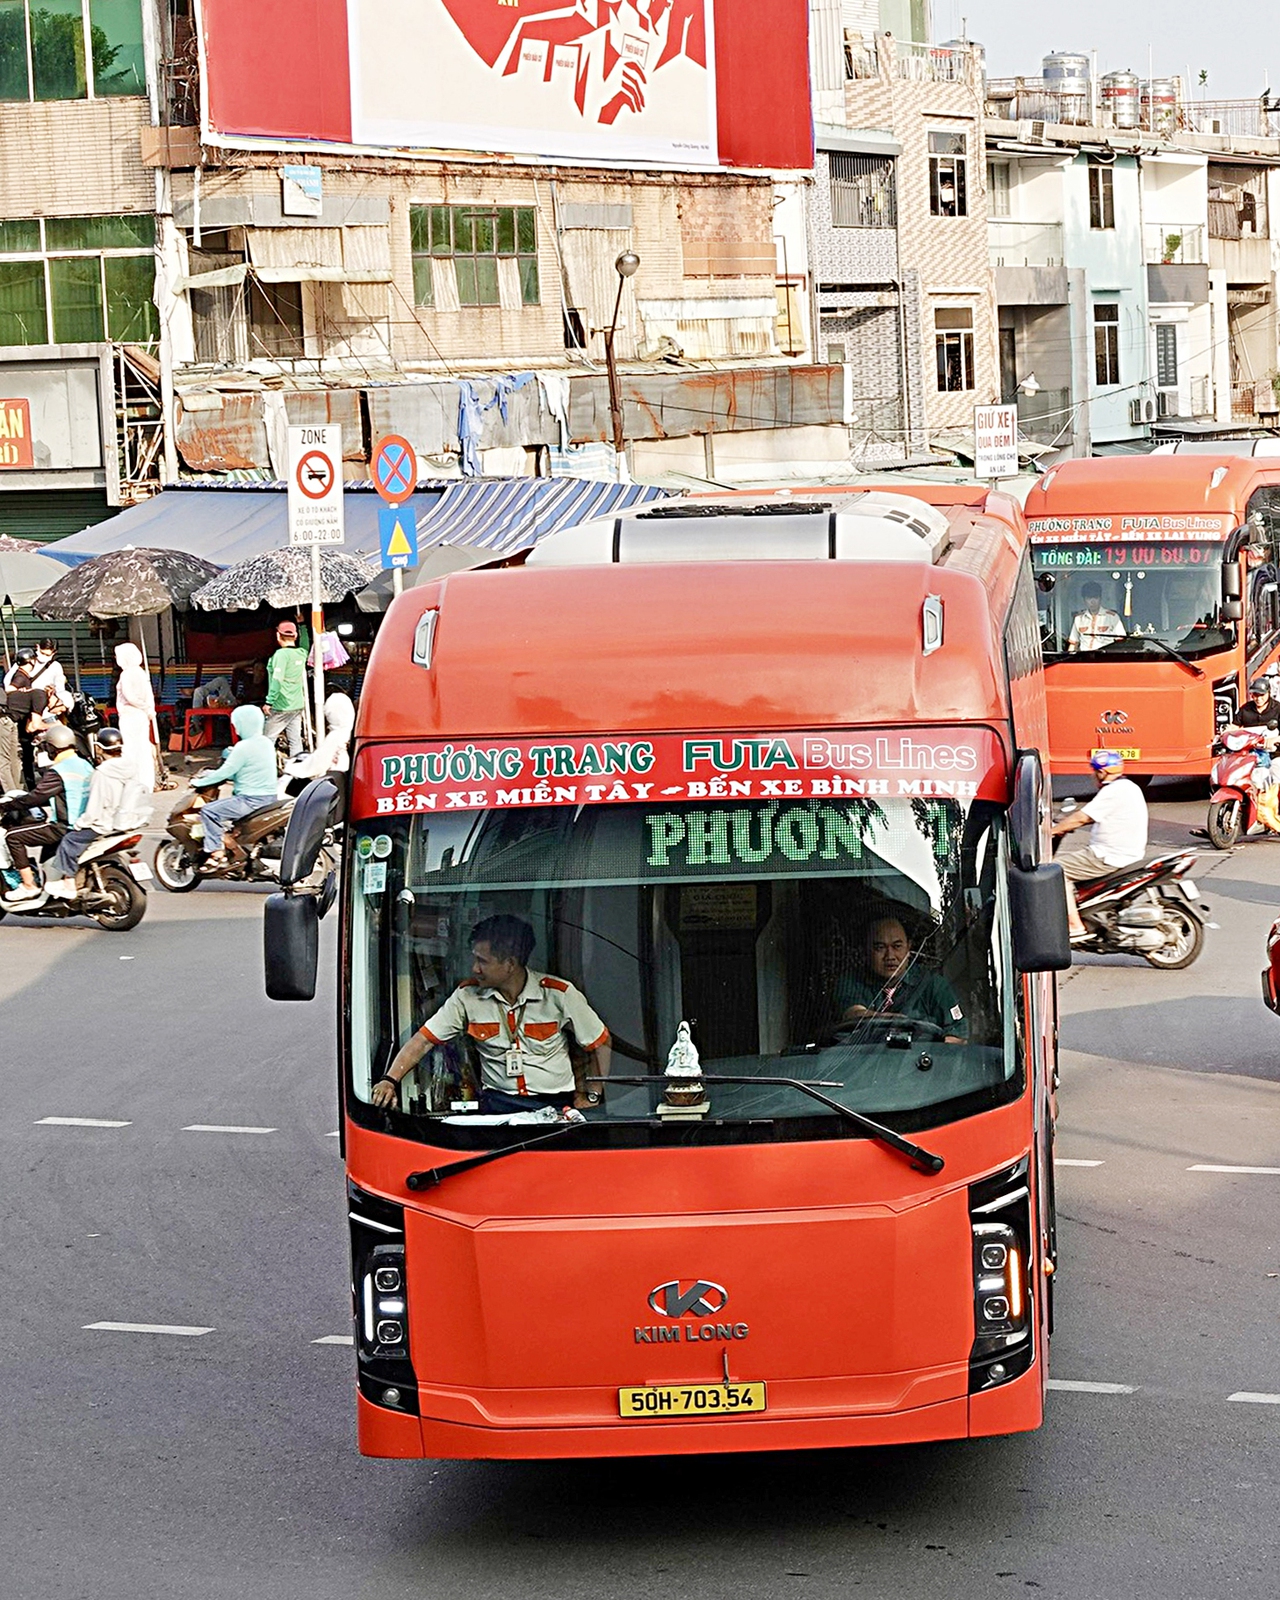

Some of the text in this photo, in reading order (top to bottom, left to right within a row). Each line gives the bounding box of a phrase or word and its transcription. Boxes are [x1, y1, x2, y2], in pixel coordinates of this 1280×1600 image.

[997, 411, 1010, 429] XE
[301, 429, 327, 444] ZONE
[1072, 518, 1112, 530] TRANG
[1121, 517, 1159, 529] FUTA
[1146, 532, 1162, 541] XE
[1041, 545, 1072, 565] TỔNG
[1076, 547, 1101, 565] ĐÀI:
[382, 744, 523, 787] PHƯƠNG
[529, 741, 655, 777] TRANG
[683, 738, 797, 772] FUTA
[376, 774, 978, 814] BẾN XE MIỀN TÂY BẾN XE BÌNH MINH
[635, 1322, 749, 1343] KIM LONG
[631, 1388, 754, 1412] 50H-703.54
